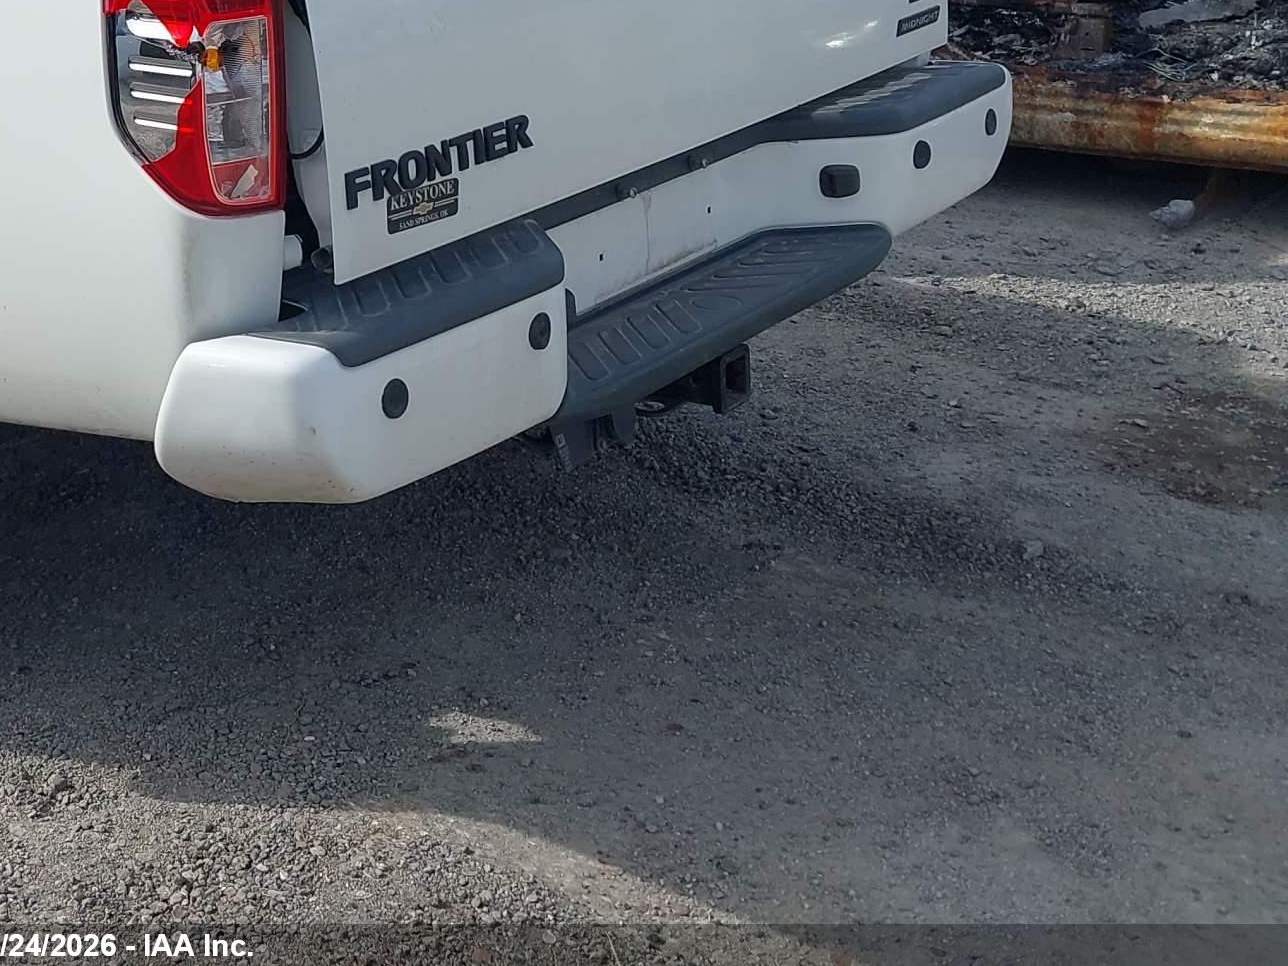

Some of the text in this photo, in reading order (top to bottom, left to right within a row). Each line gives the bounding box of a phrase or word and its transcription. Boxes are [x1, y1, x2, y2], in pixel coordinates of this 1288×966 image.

[901, 10, 939, 32] MIDNIGHT
[344, 114, 535, 211] FRONTIER
[390, 180, 455, 211] KEYSTONE
